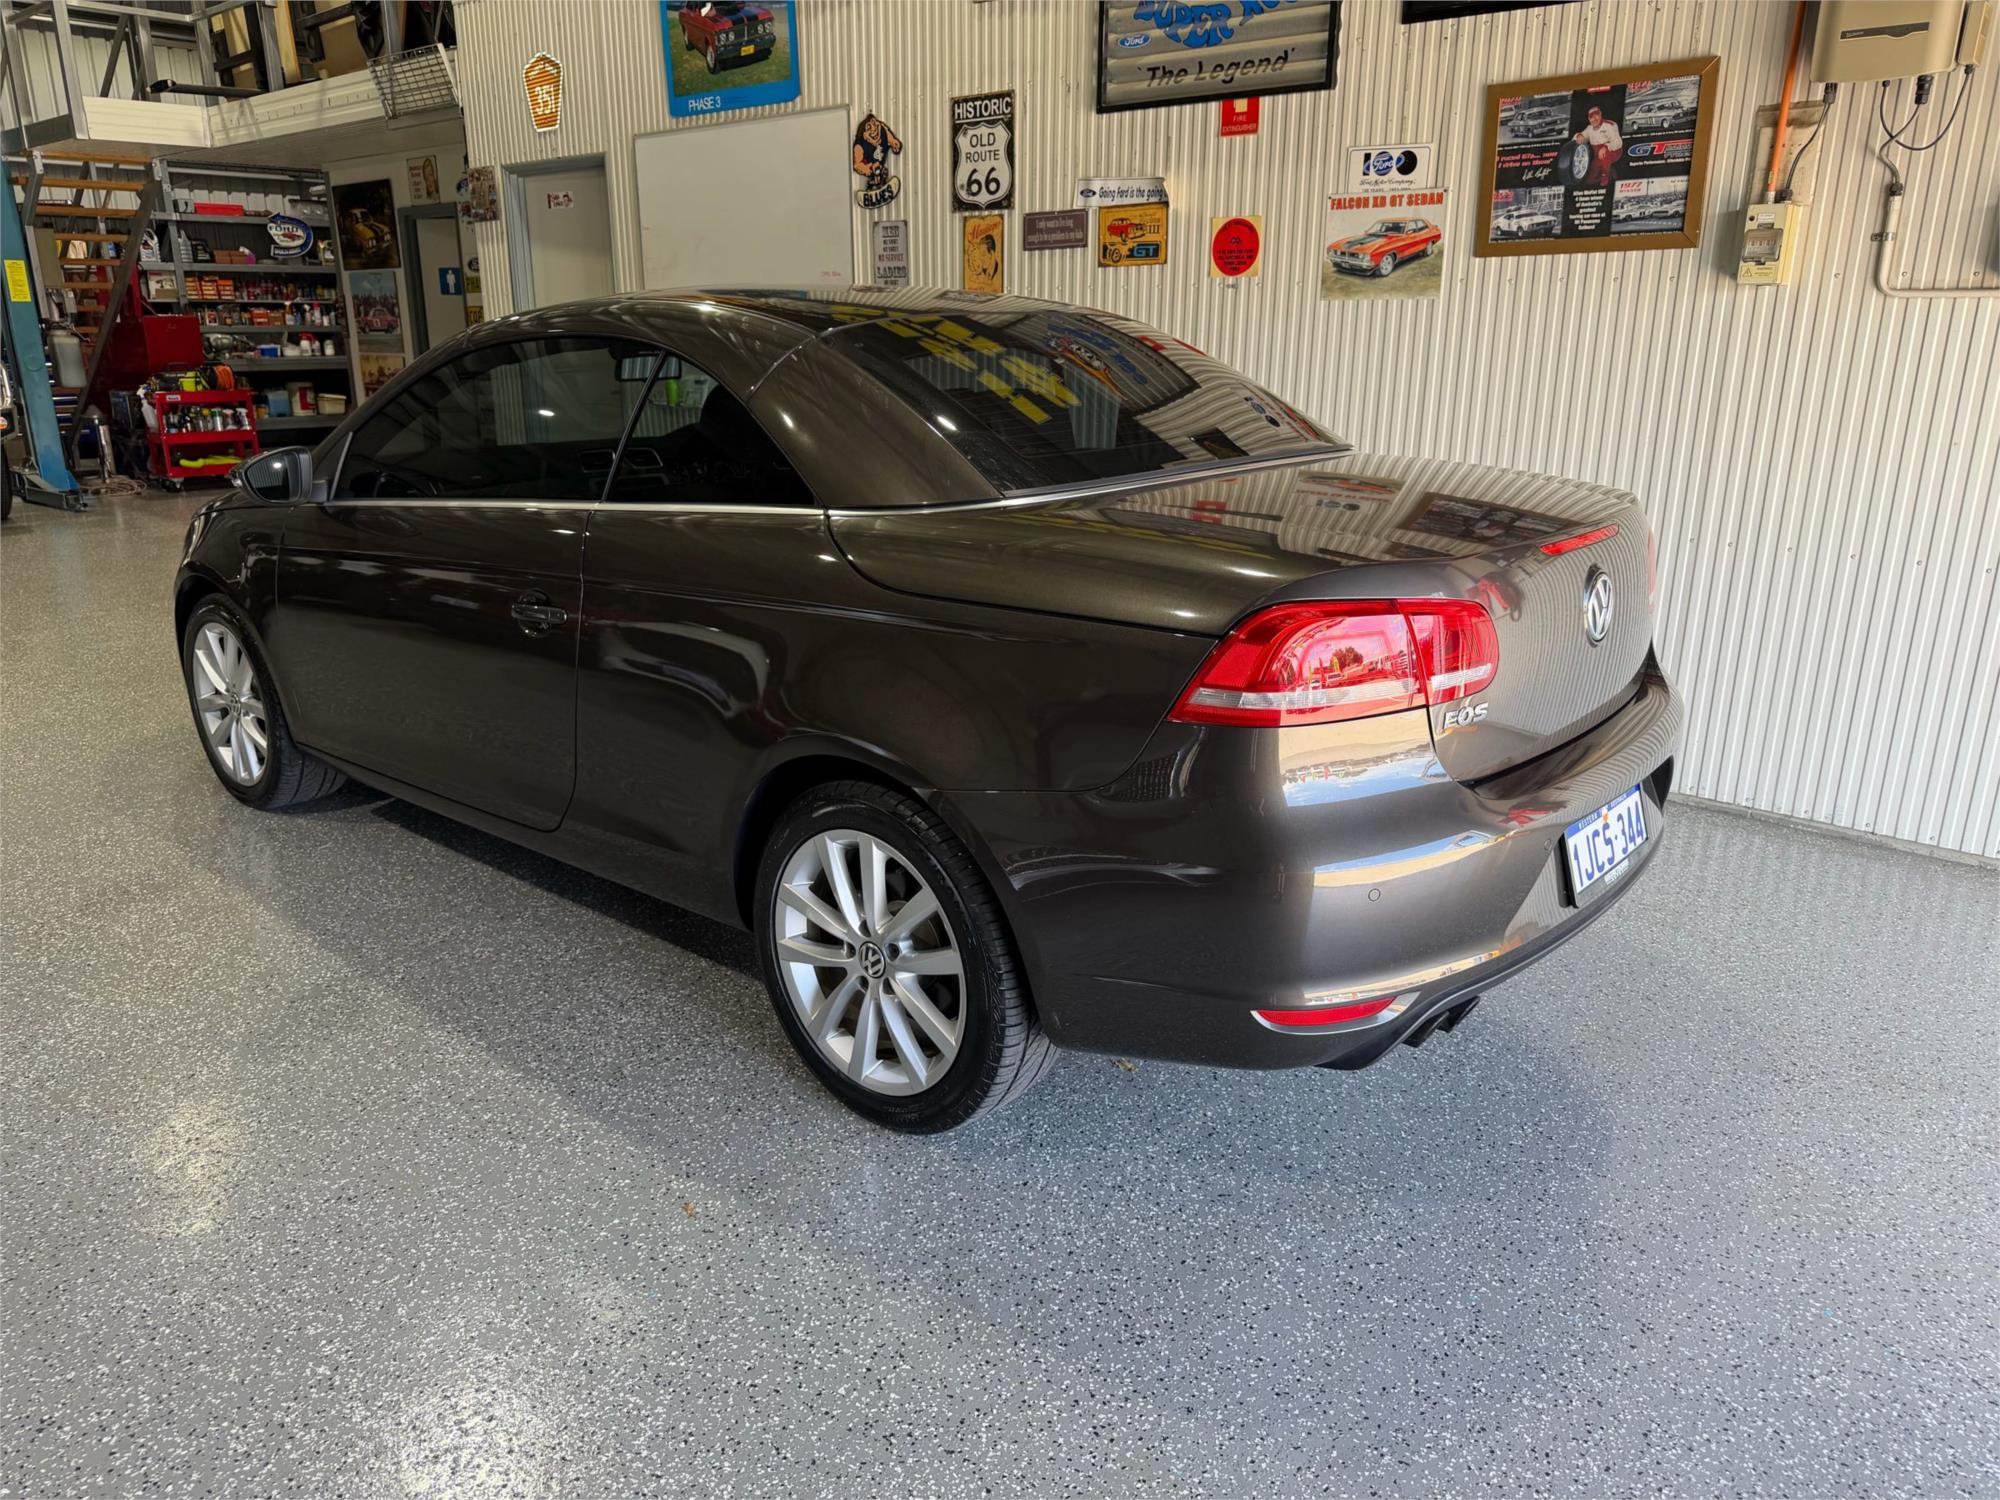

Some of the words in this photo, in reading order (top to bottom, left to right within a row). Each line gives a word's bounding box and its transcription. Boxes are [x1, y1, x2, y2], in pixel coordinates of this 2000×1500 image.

[1122, 35, 1147, 48] Ford
[535, 85, 556, 115] 351
[688, 97, 715, 112] PHASE
[715, 96, 721, 108] 3
[954, 97, 1011, 120] HISTORIC
[1232, 114, 1248, 122] FIRE
[969, 132, 997, 149] OLD
[965, 149, 1001, 164] ROUTE
[966, 166, 1000, 197] 66
[1619, 181, 1643, 189] 1977
[863, 184, 895, 207] BLUES
[1099, 187, 1116, 201] Going
[1135, 187, 1146, 198] the
[1146, 185, 1163, 201] going
[1330, 195, 1370, 210] FALCON
[1406, 192, 1444, 207] SEDAN
[1133, 245, 1158, 257] GT
[1443, 702, 1489, 730] EOS
